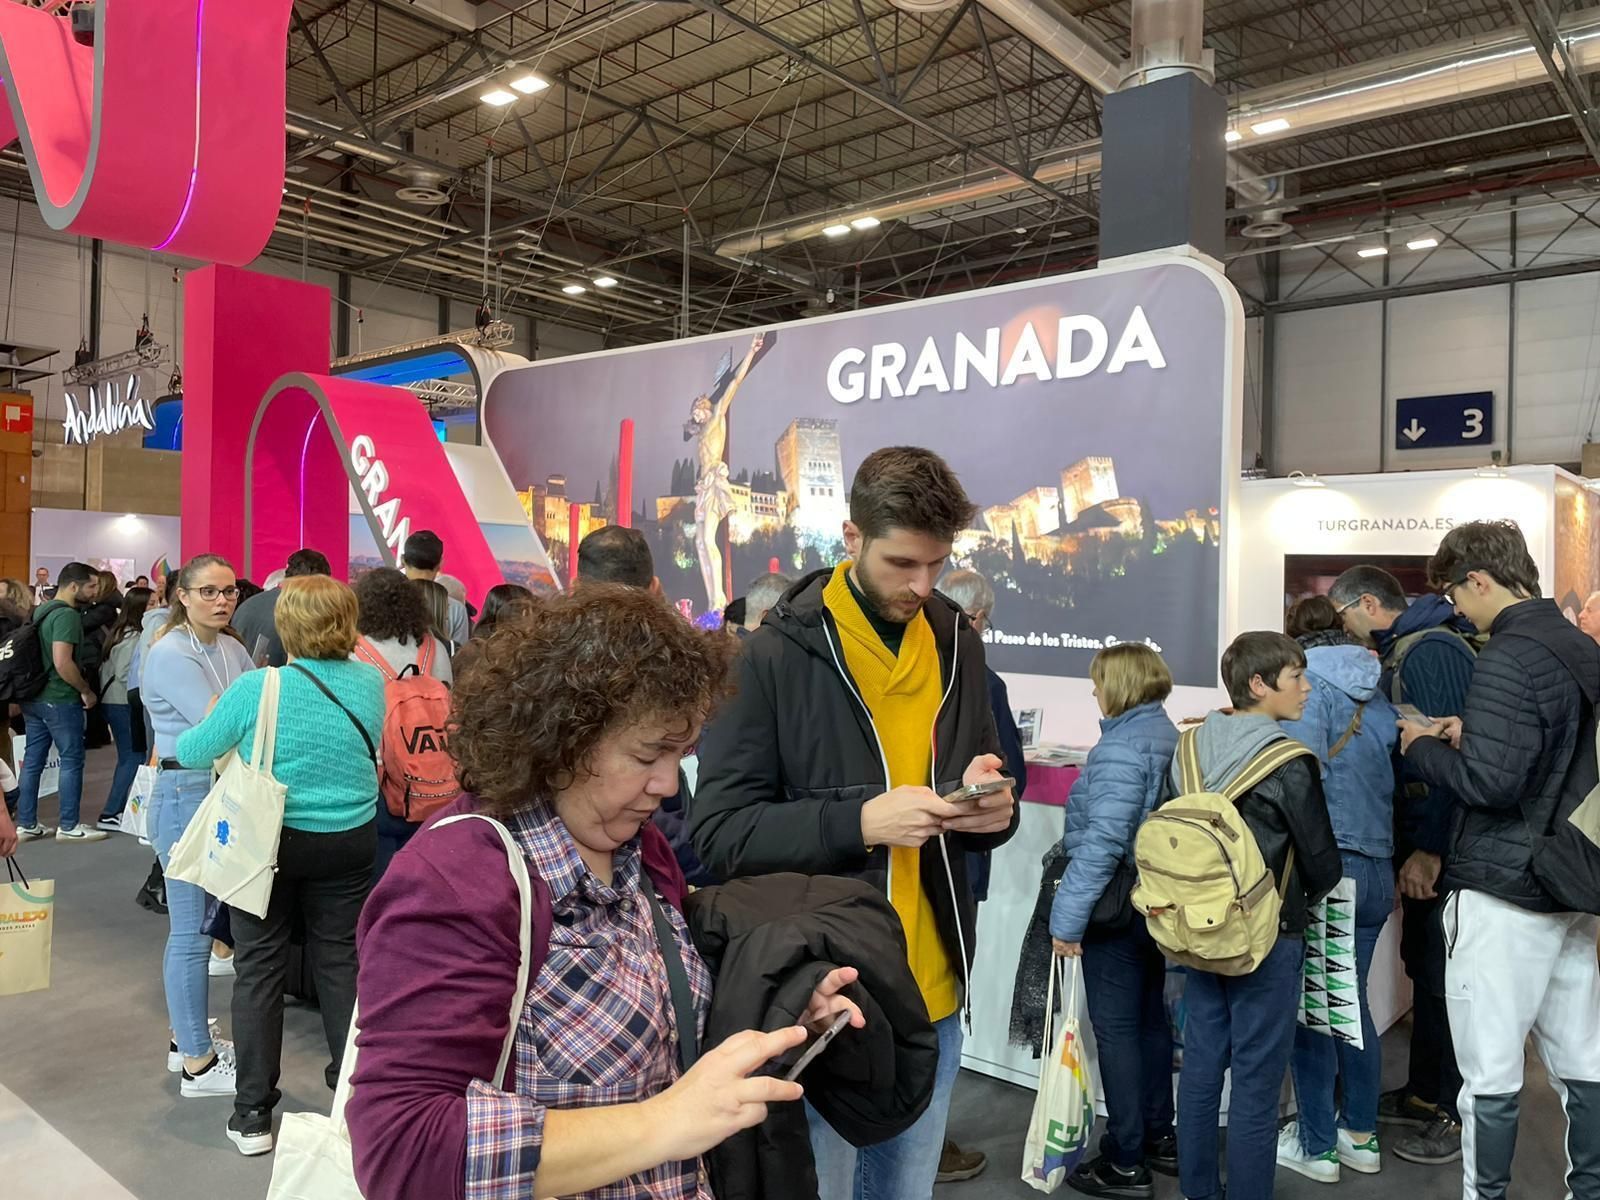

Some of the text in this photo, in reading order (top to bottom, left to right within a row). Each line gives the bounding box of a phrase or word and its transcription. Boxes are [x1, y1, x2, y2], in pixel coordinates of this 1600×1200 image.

[827, 305, 1167, 404] GRANADA
[62, 374, 154, 445] Andalucía
[1461, 408, 1484, 439] 3
[1317, 517, 1454, 531] TURGRANADA.ES
[994, 630, 1026, 645] Paseo
[1027, 631, 1042, 646] de
[1043, 632, 1060, 648] los
